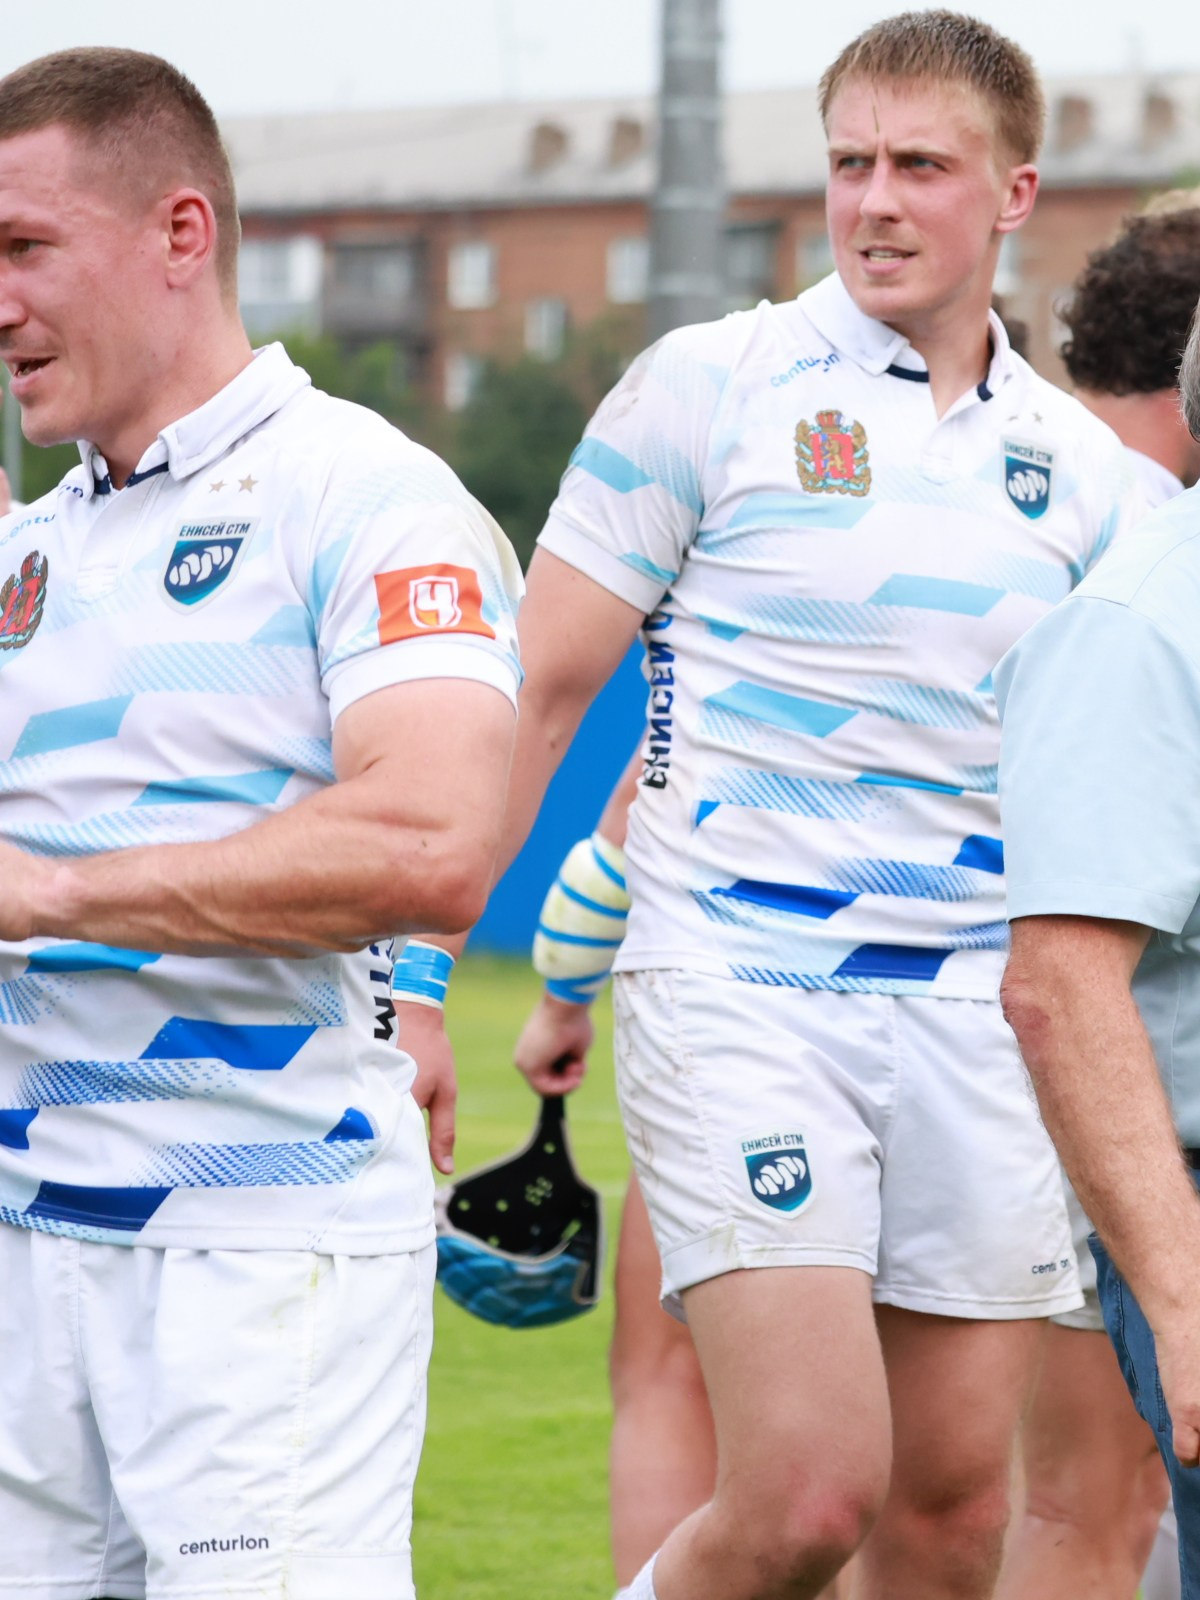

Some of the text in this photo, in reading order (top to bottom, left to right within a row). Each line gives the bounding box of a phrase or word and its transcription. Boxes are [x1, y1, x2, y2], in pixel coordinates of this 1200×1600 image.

[178, 521, 251, 537] ЕНИСЕЙ СТМ
[741, 1133, 804, 1153] ЕНИСЕЙ СТМ
[179, 1534, 269, 1555] centurion
